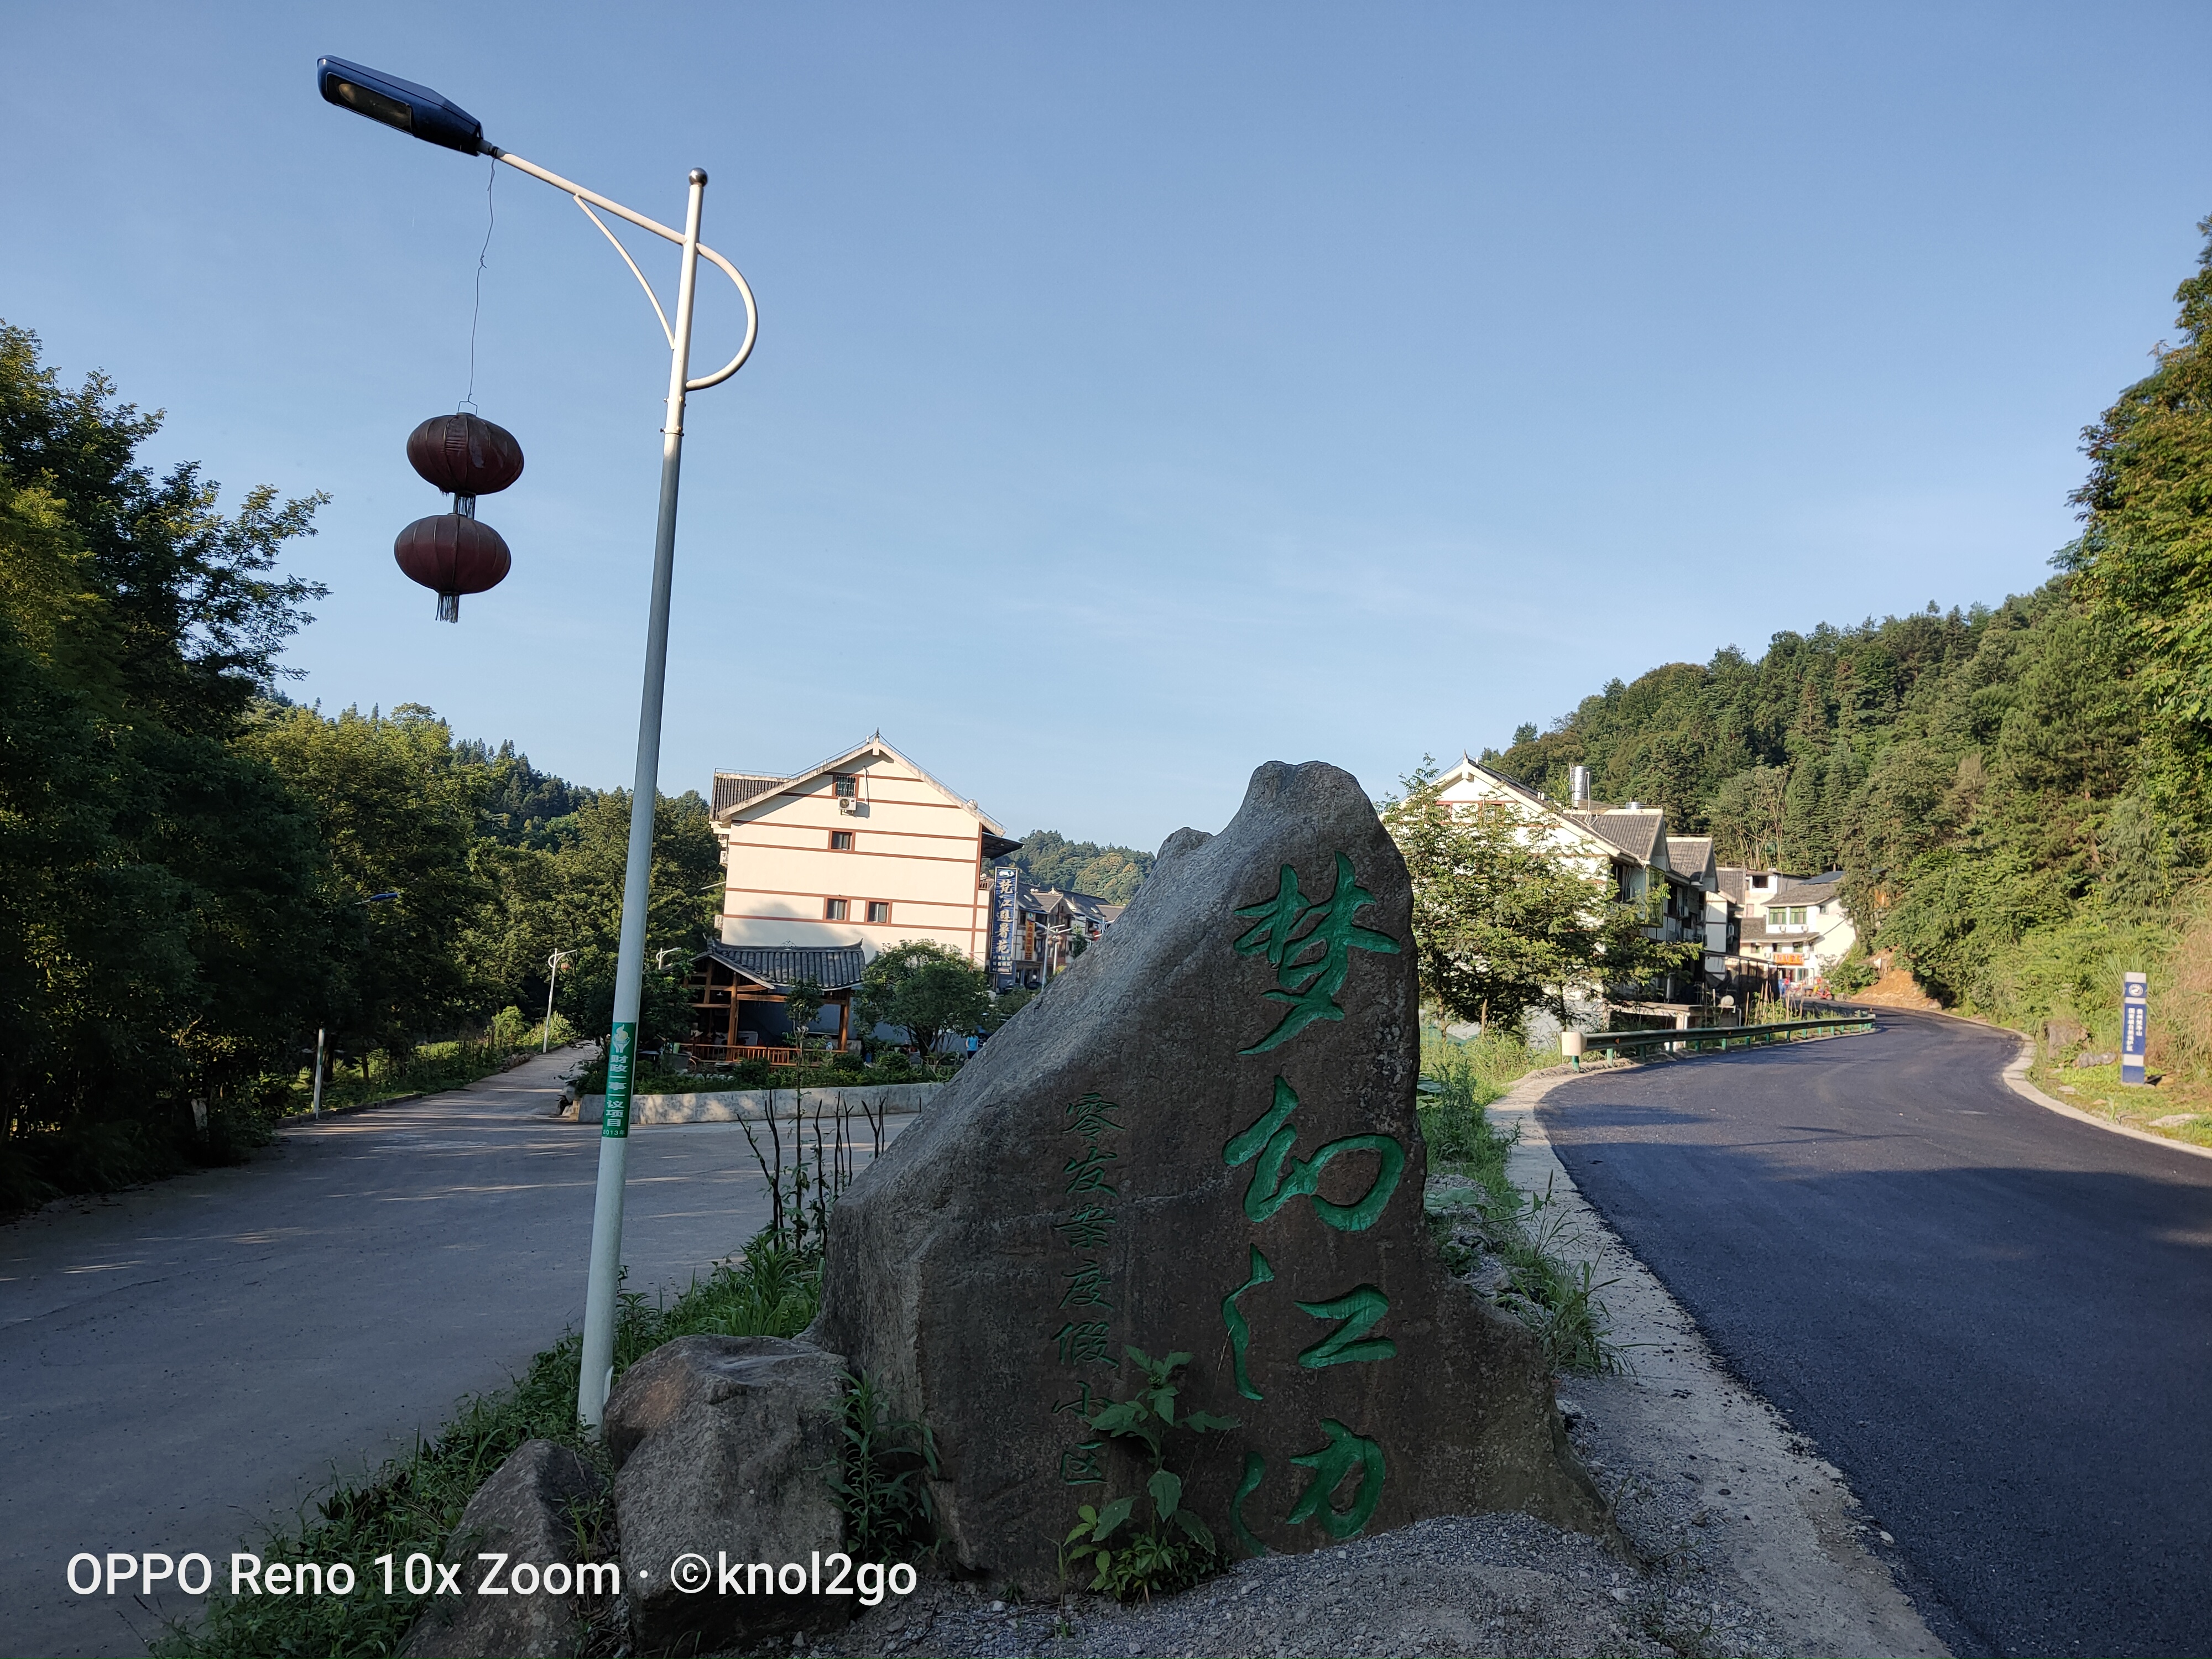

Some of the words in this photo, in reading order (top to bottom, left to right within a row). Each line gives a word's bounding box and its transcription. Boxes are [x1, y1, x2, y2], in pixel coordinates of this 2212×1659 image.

[606, 1055, 628, 1126] 财政一事一议项目
